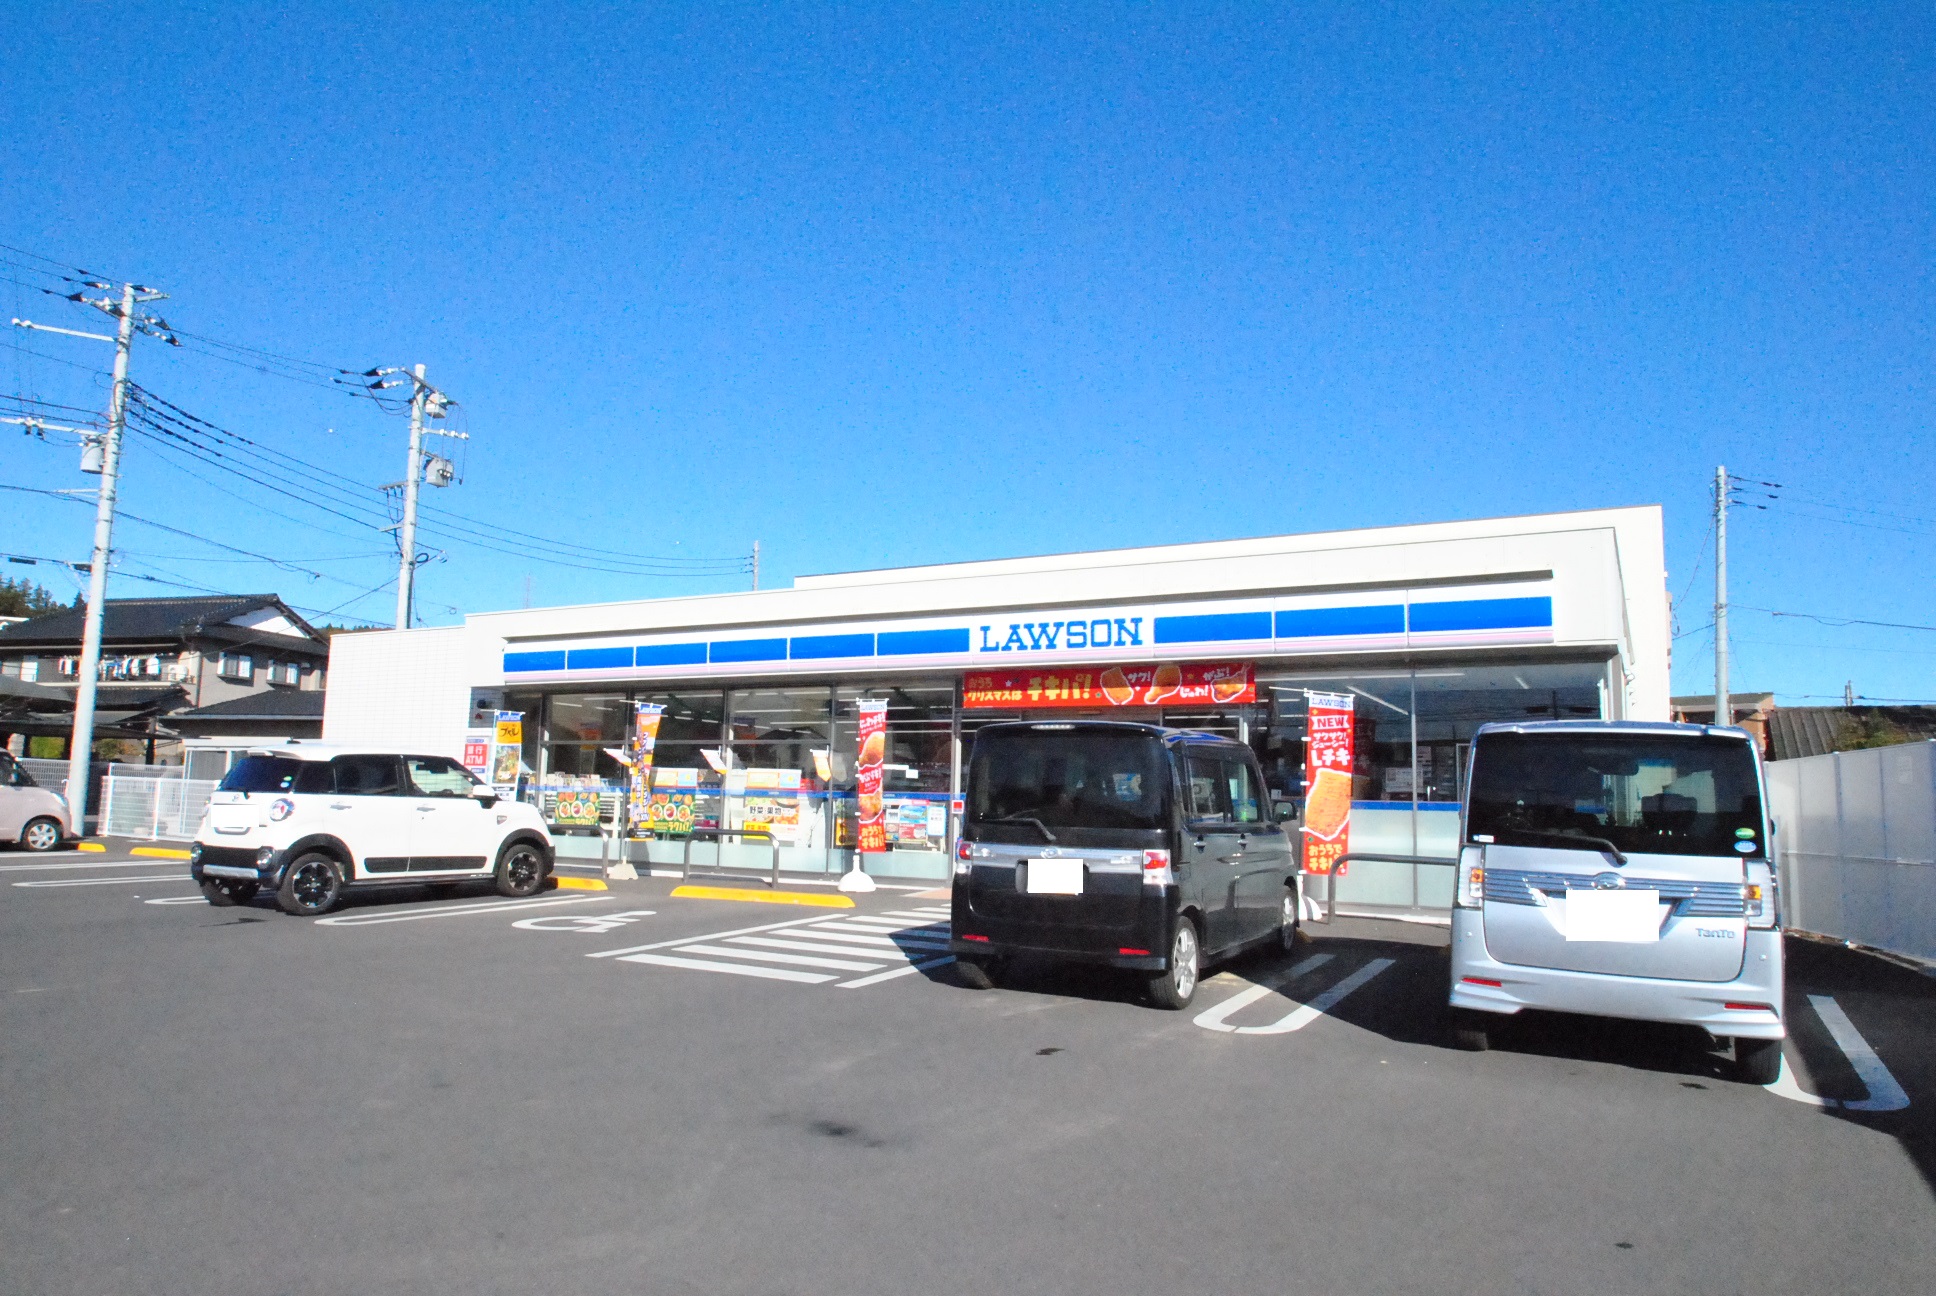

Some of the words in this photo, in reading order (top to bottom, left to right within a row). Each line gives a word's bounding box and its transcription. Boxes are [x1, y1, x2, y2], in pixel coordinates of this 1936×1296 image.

[980, 617, 1143, 652] LAWSON
[967, 676, 993, 690] おうち
[1127, 670, 1151, 683] サク!
[1026, 673, 1093, 701] チキパ!
[1179, 684, 1209, 698] じゅわ!
[967, 689, 1023, 702] クリスマスは
[1311, 697, 1351, 708] LAWSON
[1316, 717, 1345, 728] NEW
[1312, 731, 1347, 741] サクサク!
[1311, 738, 1349, 749] ジューシー!
[465, 755, 483, 765] ATM
[1311, 748, 1350, 766] Lチキ
[1308, 843, 1343, 857] おうちで
